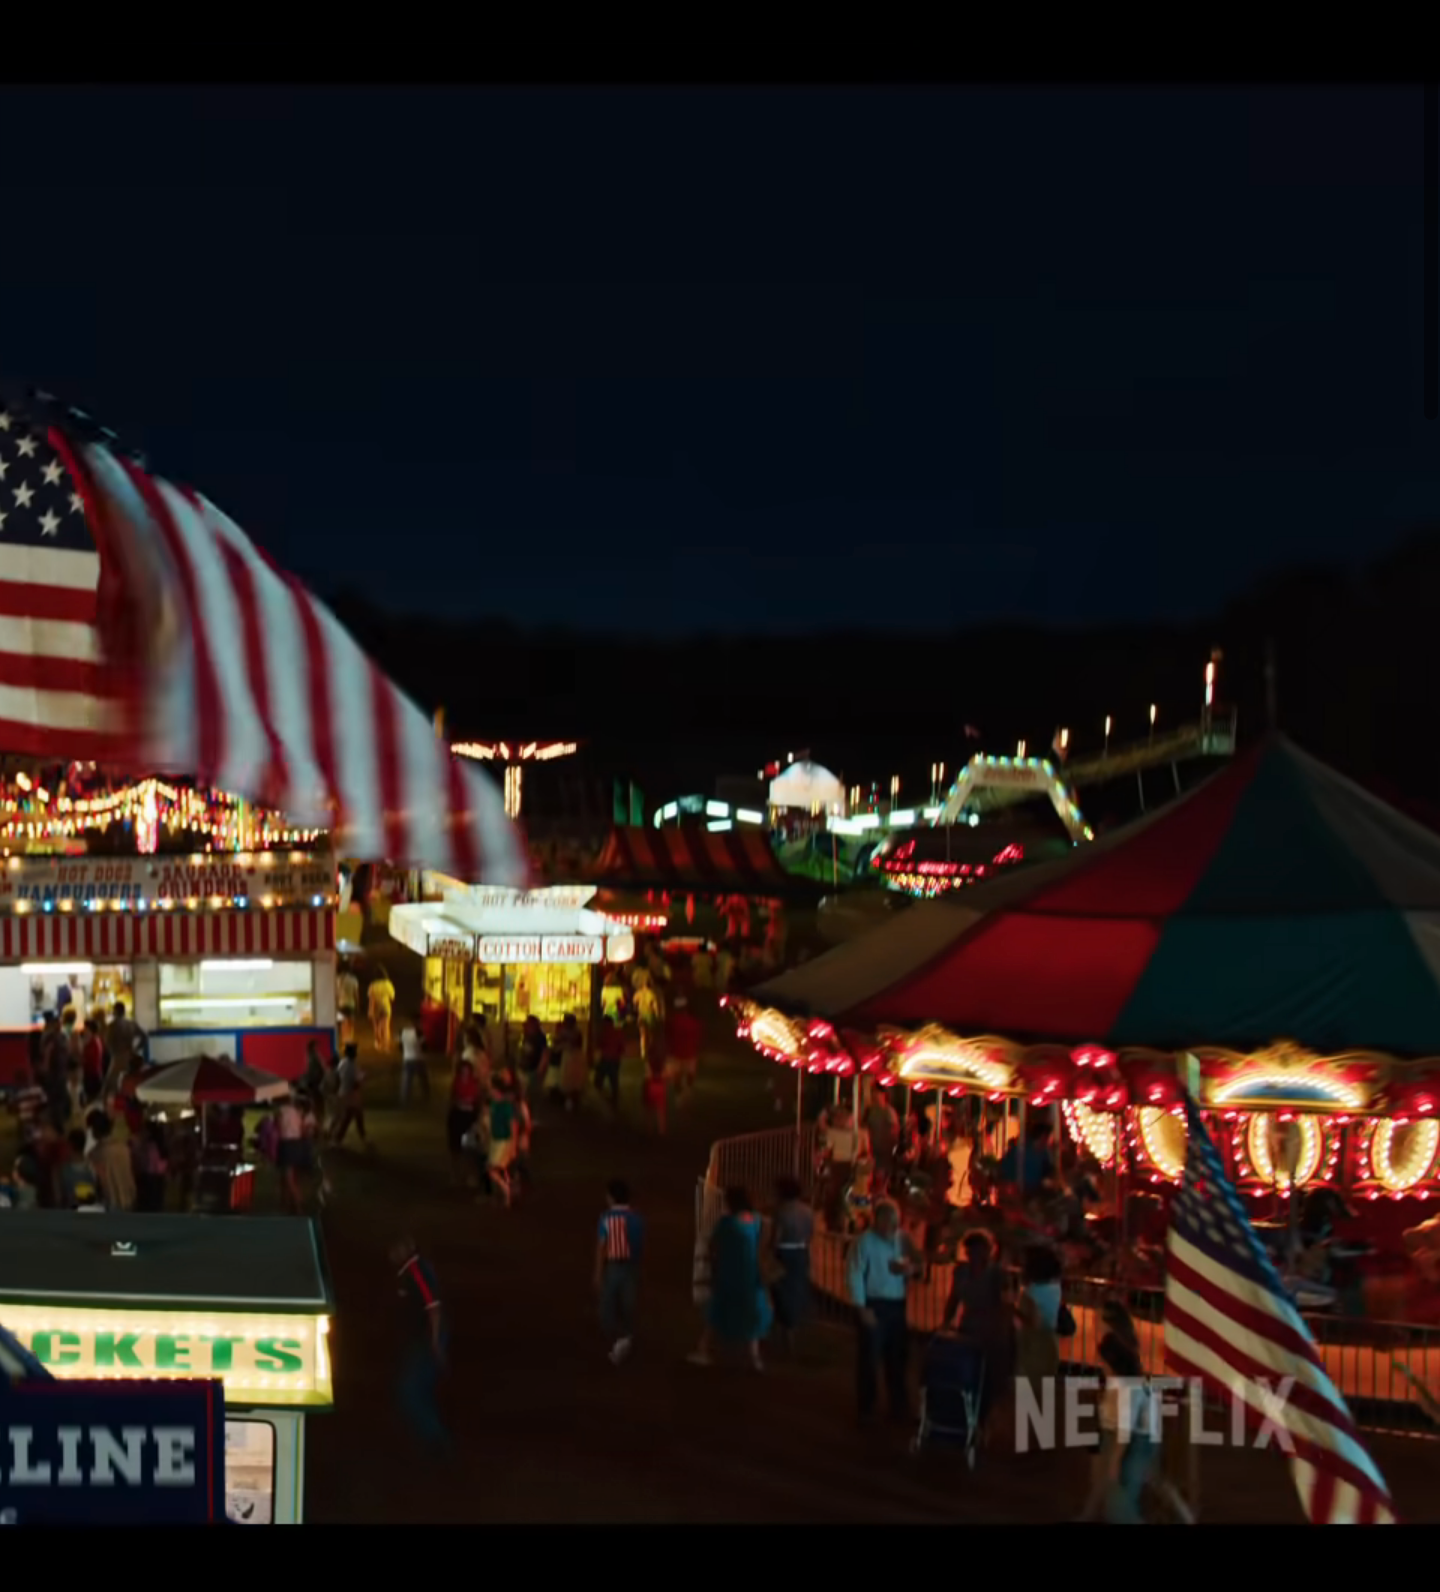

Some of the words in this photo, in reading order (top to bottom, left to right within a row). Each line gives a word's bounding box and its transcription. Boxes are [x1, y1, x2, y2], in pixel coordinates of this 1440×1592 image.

[57, 864, 87, 882] HOT
[94, 864, 133, 882] DOGS
[17, 883, 142, 902] HAMBURGERS
[483, 940, 541, 957] COTTON
[546, 940, 595, 957] CANDY
[30, 1330, 303, 1373] CKETS
